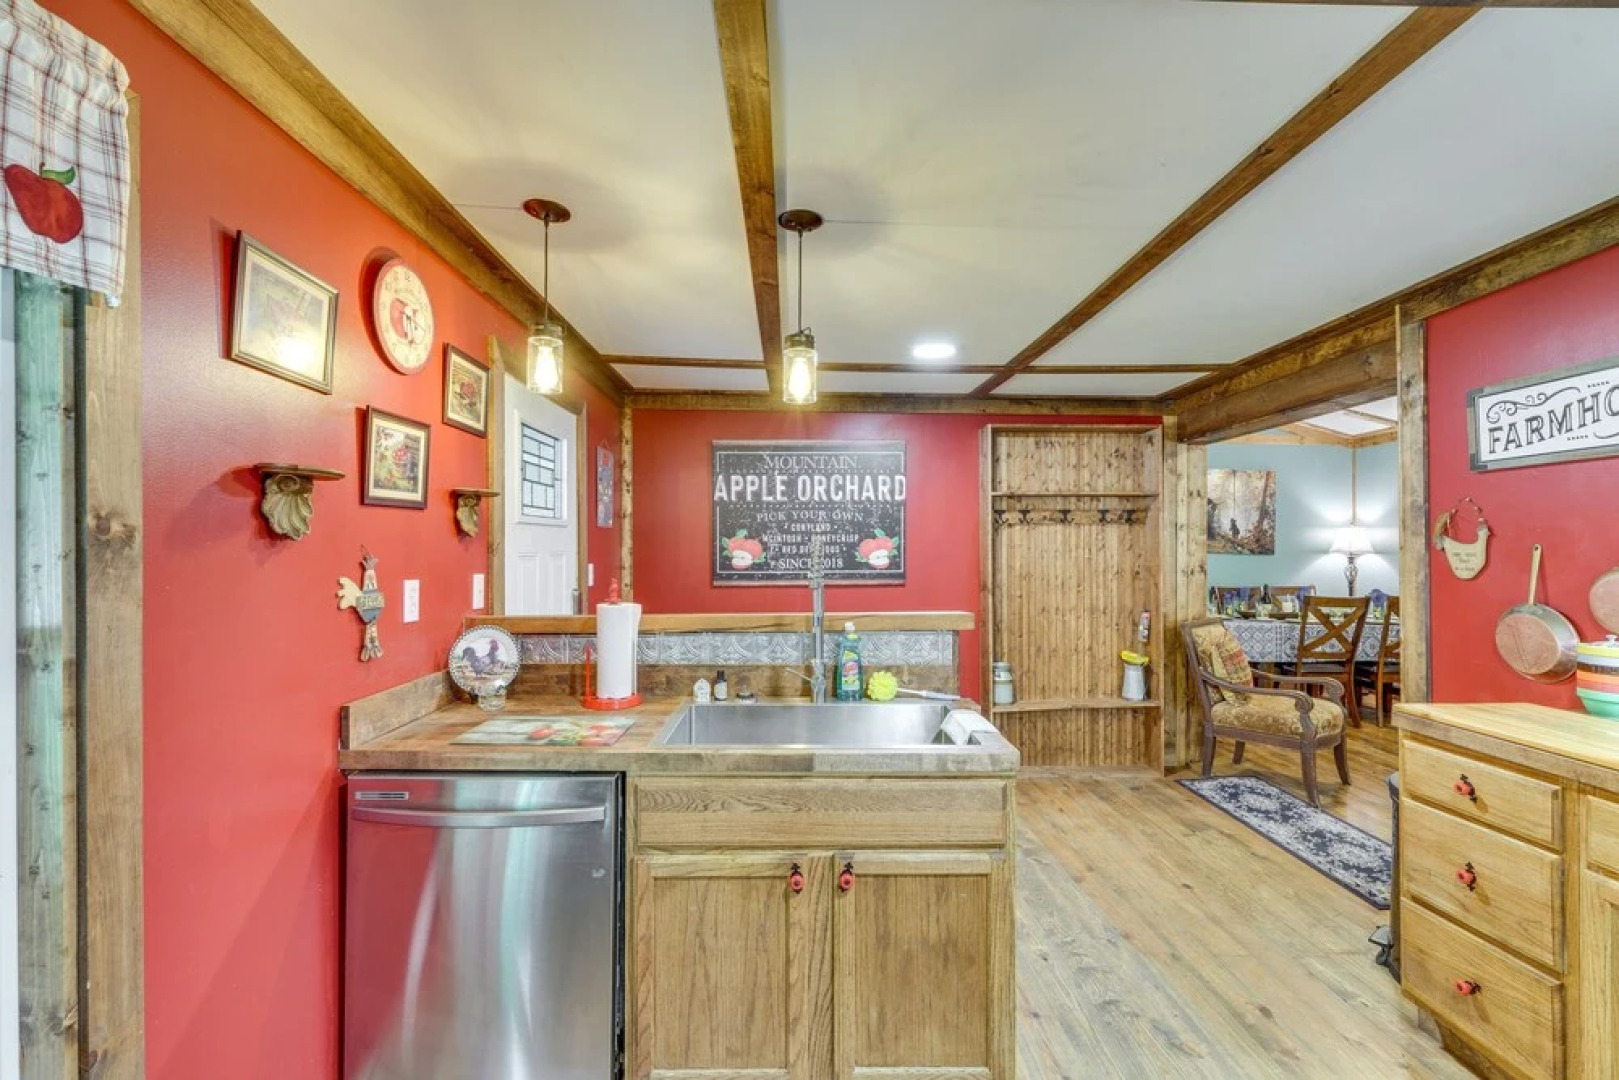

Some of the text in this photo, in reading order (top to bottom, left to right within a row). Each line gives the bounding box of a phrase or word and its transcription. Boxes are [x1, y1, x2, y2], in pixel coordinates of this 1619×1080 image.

[764, 456, 858, 469] MOUNTAIN
[714, 474, 906, 501] APPLE ORCHARD
[757, 510, 864, 522] PICK YOUR OWN
[800, 545, 840, 553] DEOUS
[818, 559, 844, 568] 018
